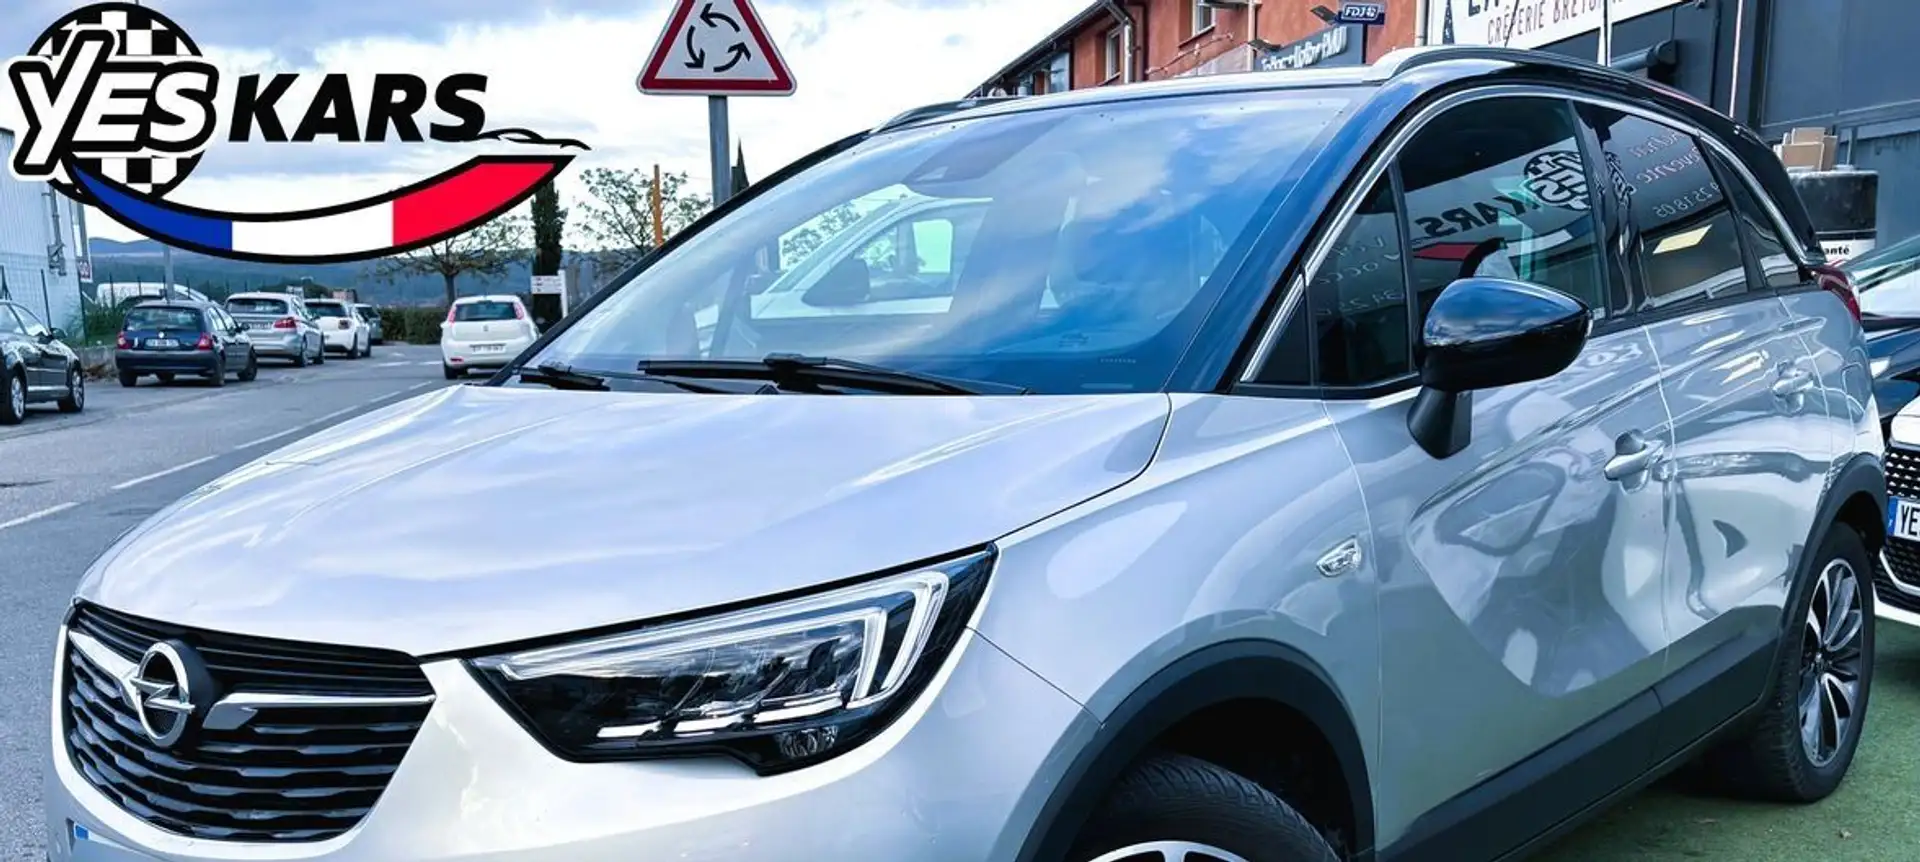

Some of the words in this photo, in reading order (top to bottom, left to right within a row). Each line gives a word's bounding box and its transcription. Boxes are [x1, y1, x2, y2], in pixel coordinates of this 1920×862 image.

[1344, 6, 1366, 17] FDJ
[1823, 244, 1851, 256] anté
[1900, 504, 1920, 536] YE
